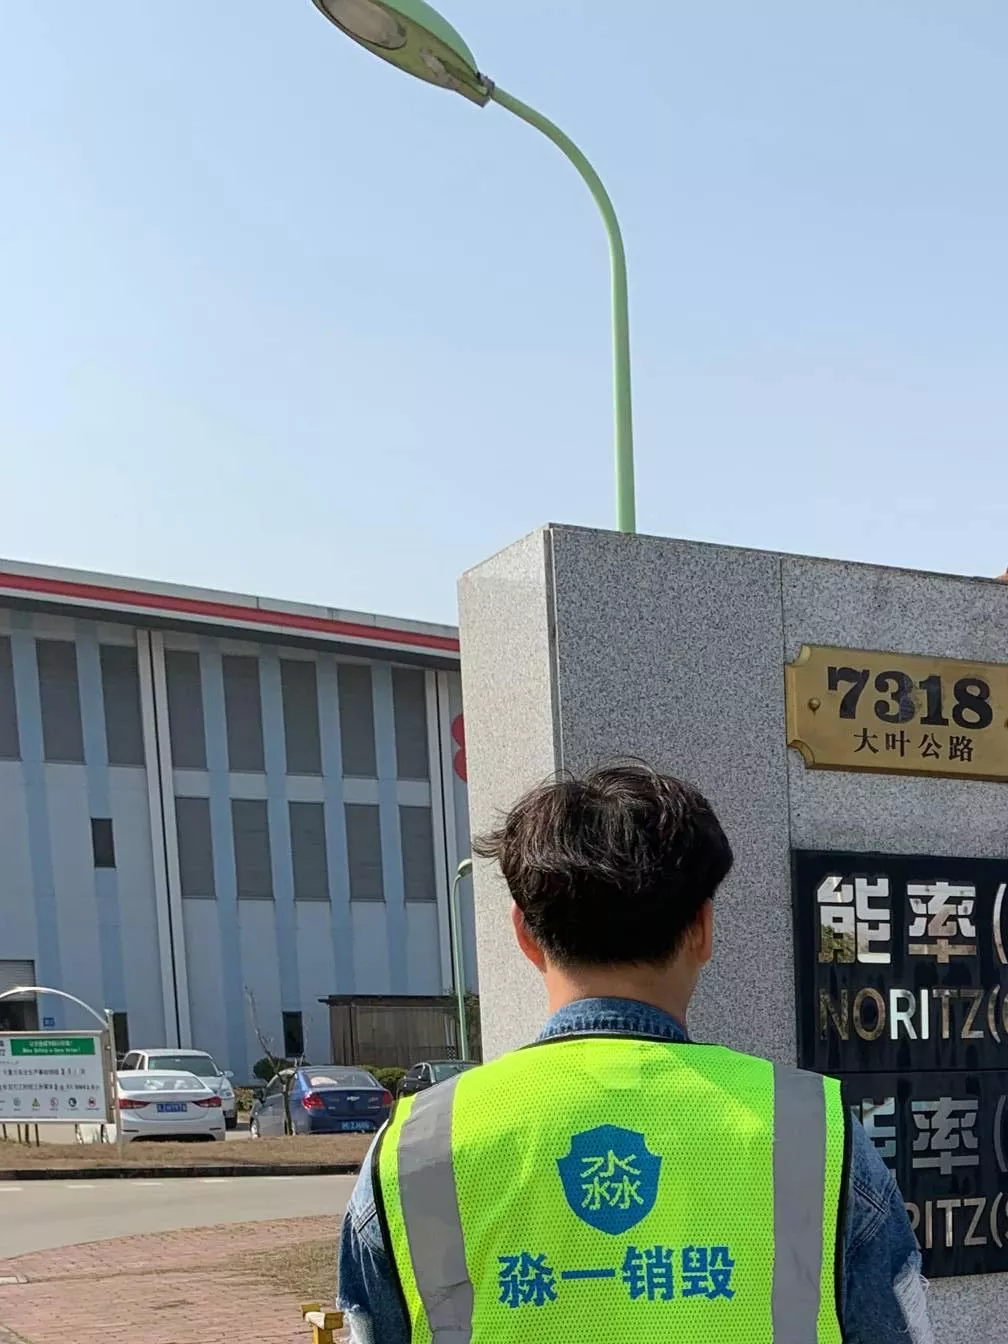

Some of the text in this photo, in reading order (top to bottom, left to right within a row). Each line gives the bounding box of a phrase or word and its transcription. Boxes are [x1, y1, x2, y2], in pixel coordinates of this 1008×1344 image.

[827, 667, 993, 729] 7318
[853, 728, 973, 762] 大叶公路
